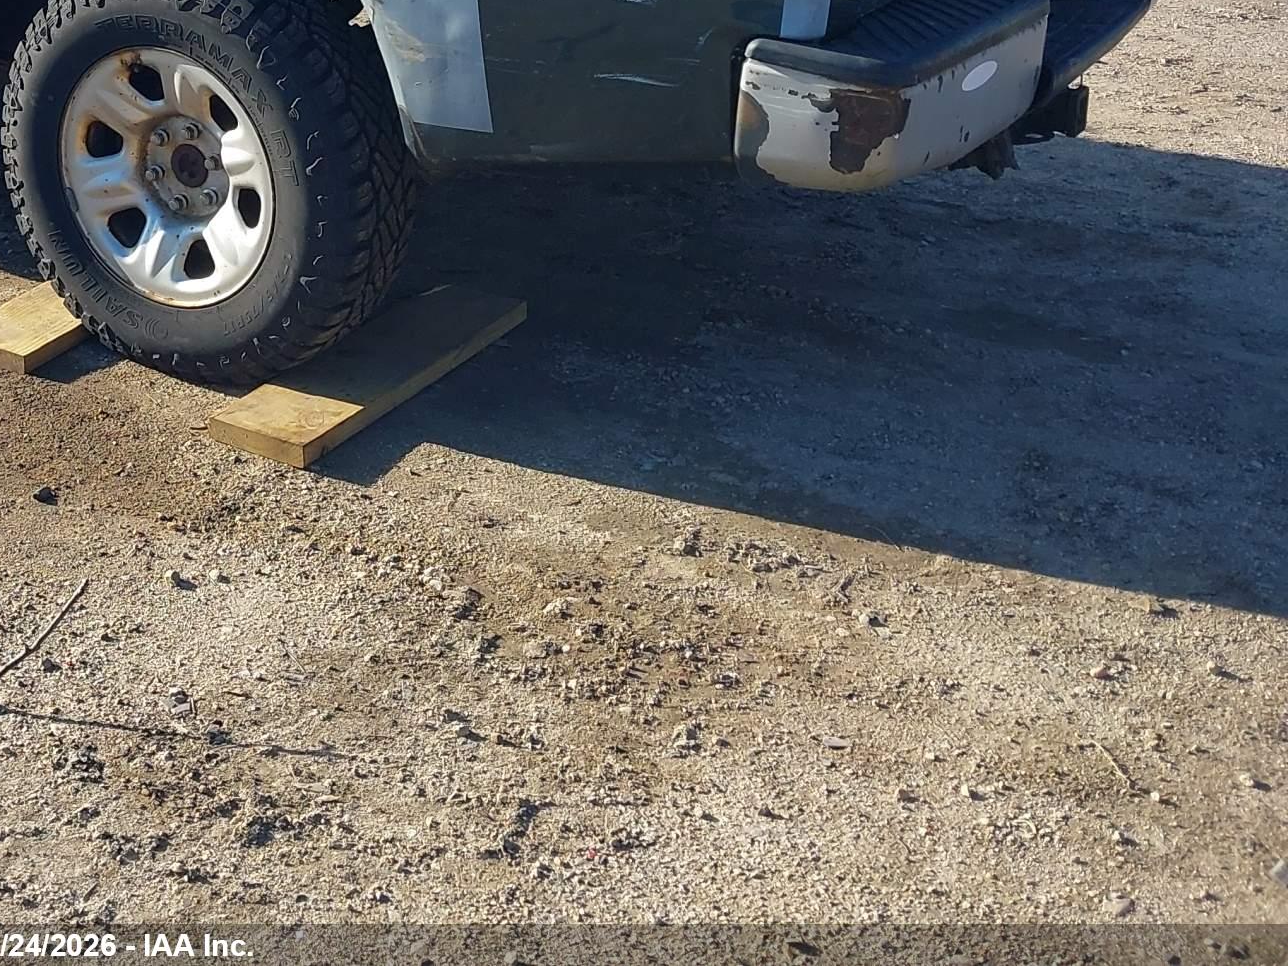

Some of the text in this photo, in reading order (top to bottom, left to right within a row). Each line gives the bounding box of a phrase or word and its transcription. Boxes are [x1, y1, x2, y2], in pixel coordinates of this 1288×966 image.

[94, 14, 274, 118] TERRAMAX
[269, 129, 300, 187] RT
[48, 229, 144, 330] SAILUN
